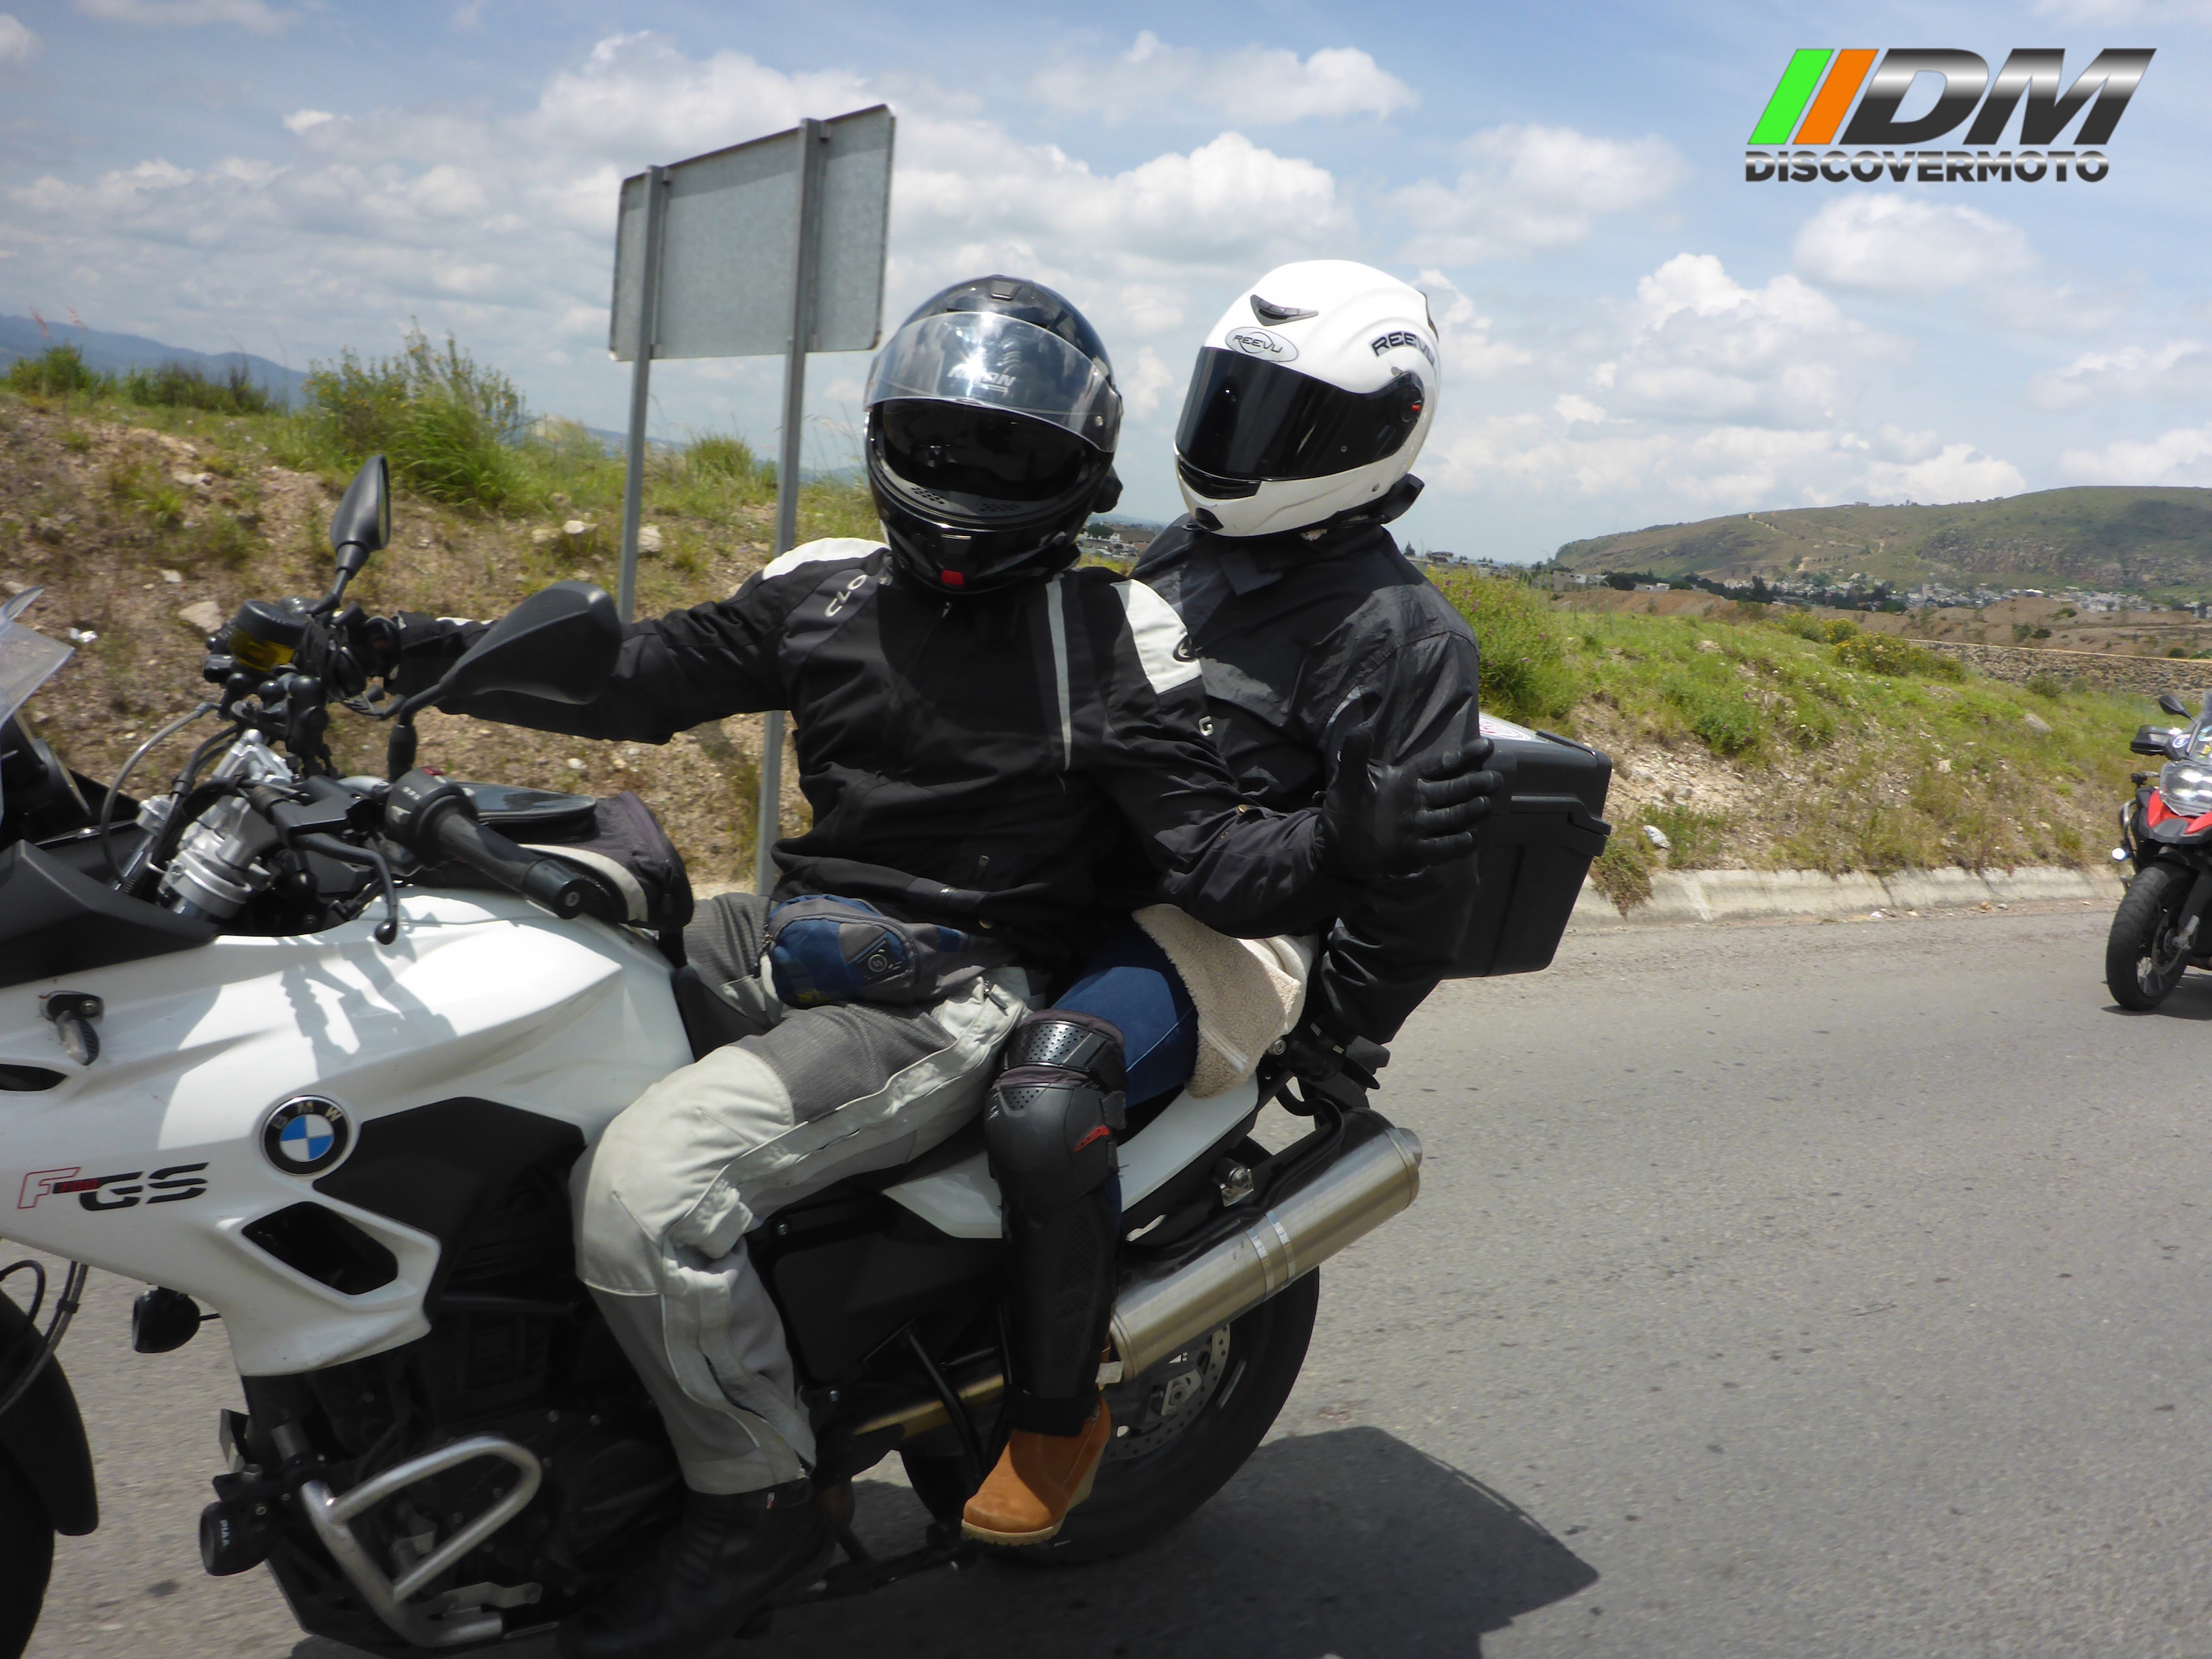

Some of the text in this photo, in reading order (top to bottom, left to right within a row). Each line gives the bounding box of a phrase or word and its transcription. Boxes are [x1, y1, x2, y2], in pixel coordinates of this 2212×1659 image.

[1233, 334, 1284, 353] REEVU
[271, 1101, 343, 1130] BMW
[54, 1161, 210, 1211] GS
